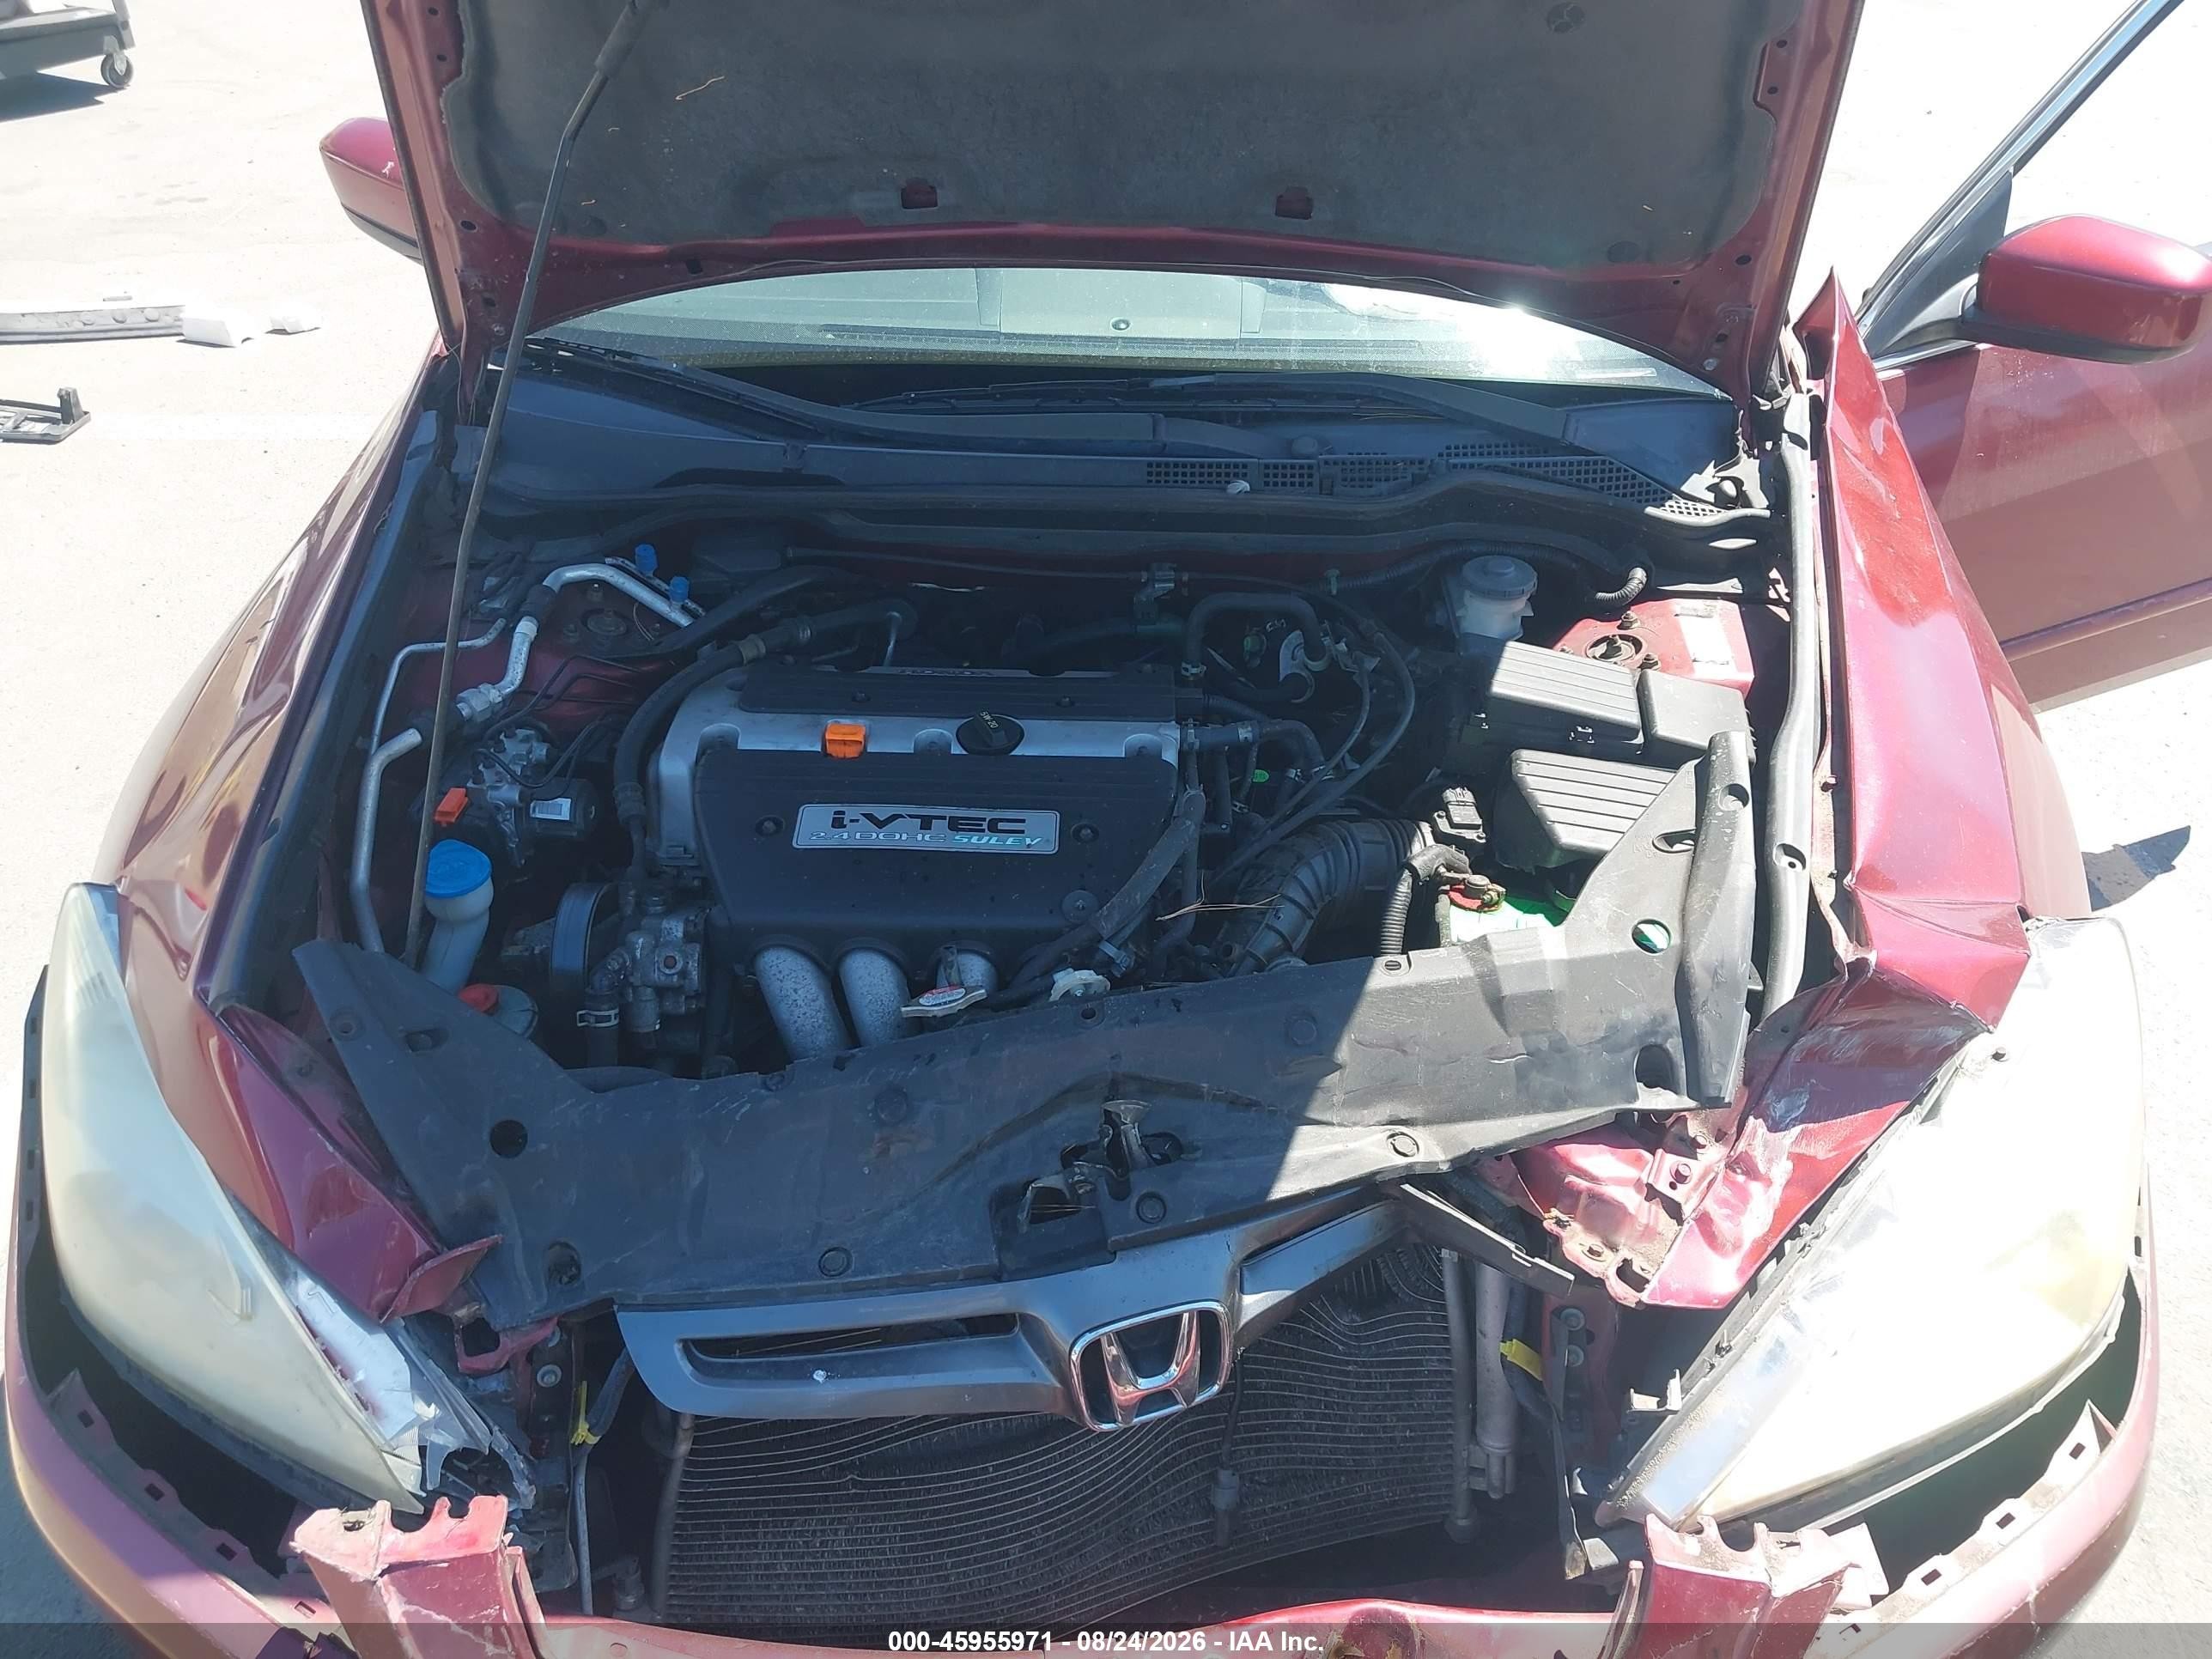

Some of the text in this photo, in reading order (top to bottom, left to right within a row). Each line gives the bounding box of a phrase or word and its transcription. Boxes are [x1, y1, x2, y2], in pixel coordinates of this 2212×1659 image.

[980, 711, 999, 728] 5W-20
[830, 810, 1026, 835] i-VTEC
[809, 831, 1042, 847] 2.4 DOHC SULEV
